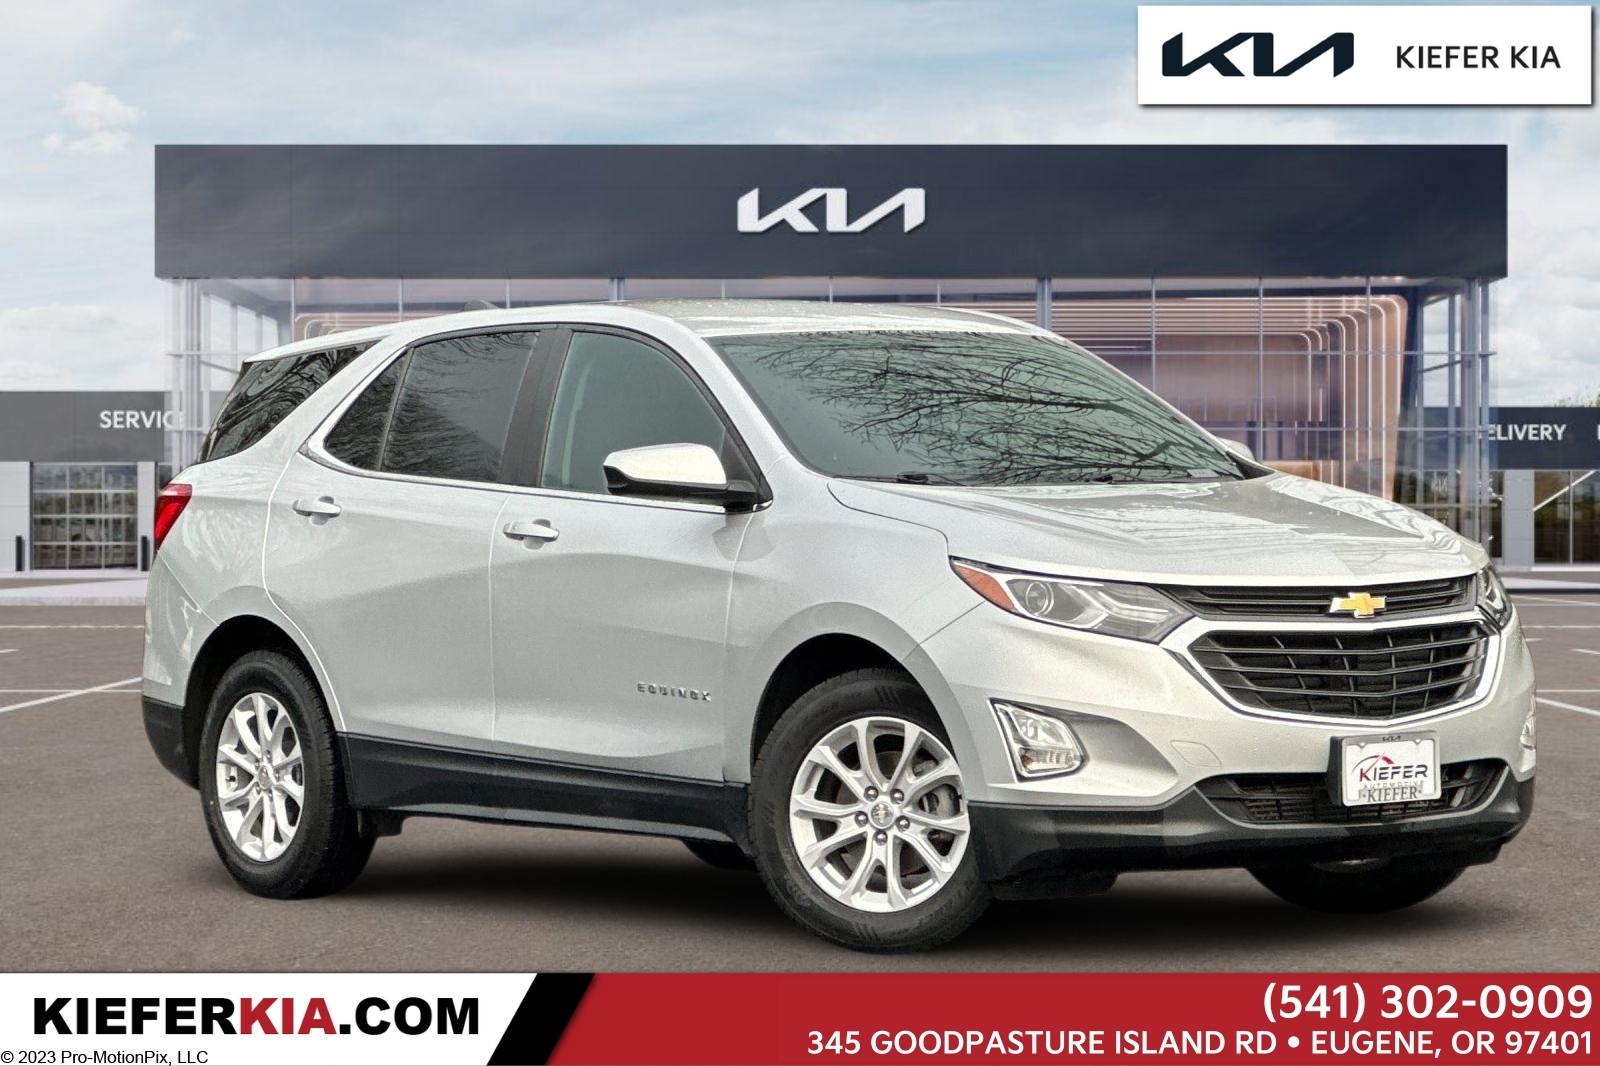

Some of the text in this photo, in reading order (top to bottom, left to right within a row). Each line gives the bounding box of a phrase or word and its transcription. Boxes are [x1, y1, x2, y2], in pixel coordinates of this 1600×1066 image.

[737, 187, 926, 233] KIA
[99, 409, 186, 429] SERVIC
[1478, 423, 1567, 441] ELIVERY
[637, 681, 712, 702] EQUINOX
[1359, 764, 1429, 782] KIEFER
[1367, 786, 1418, 803] KIEFER
